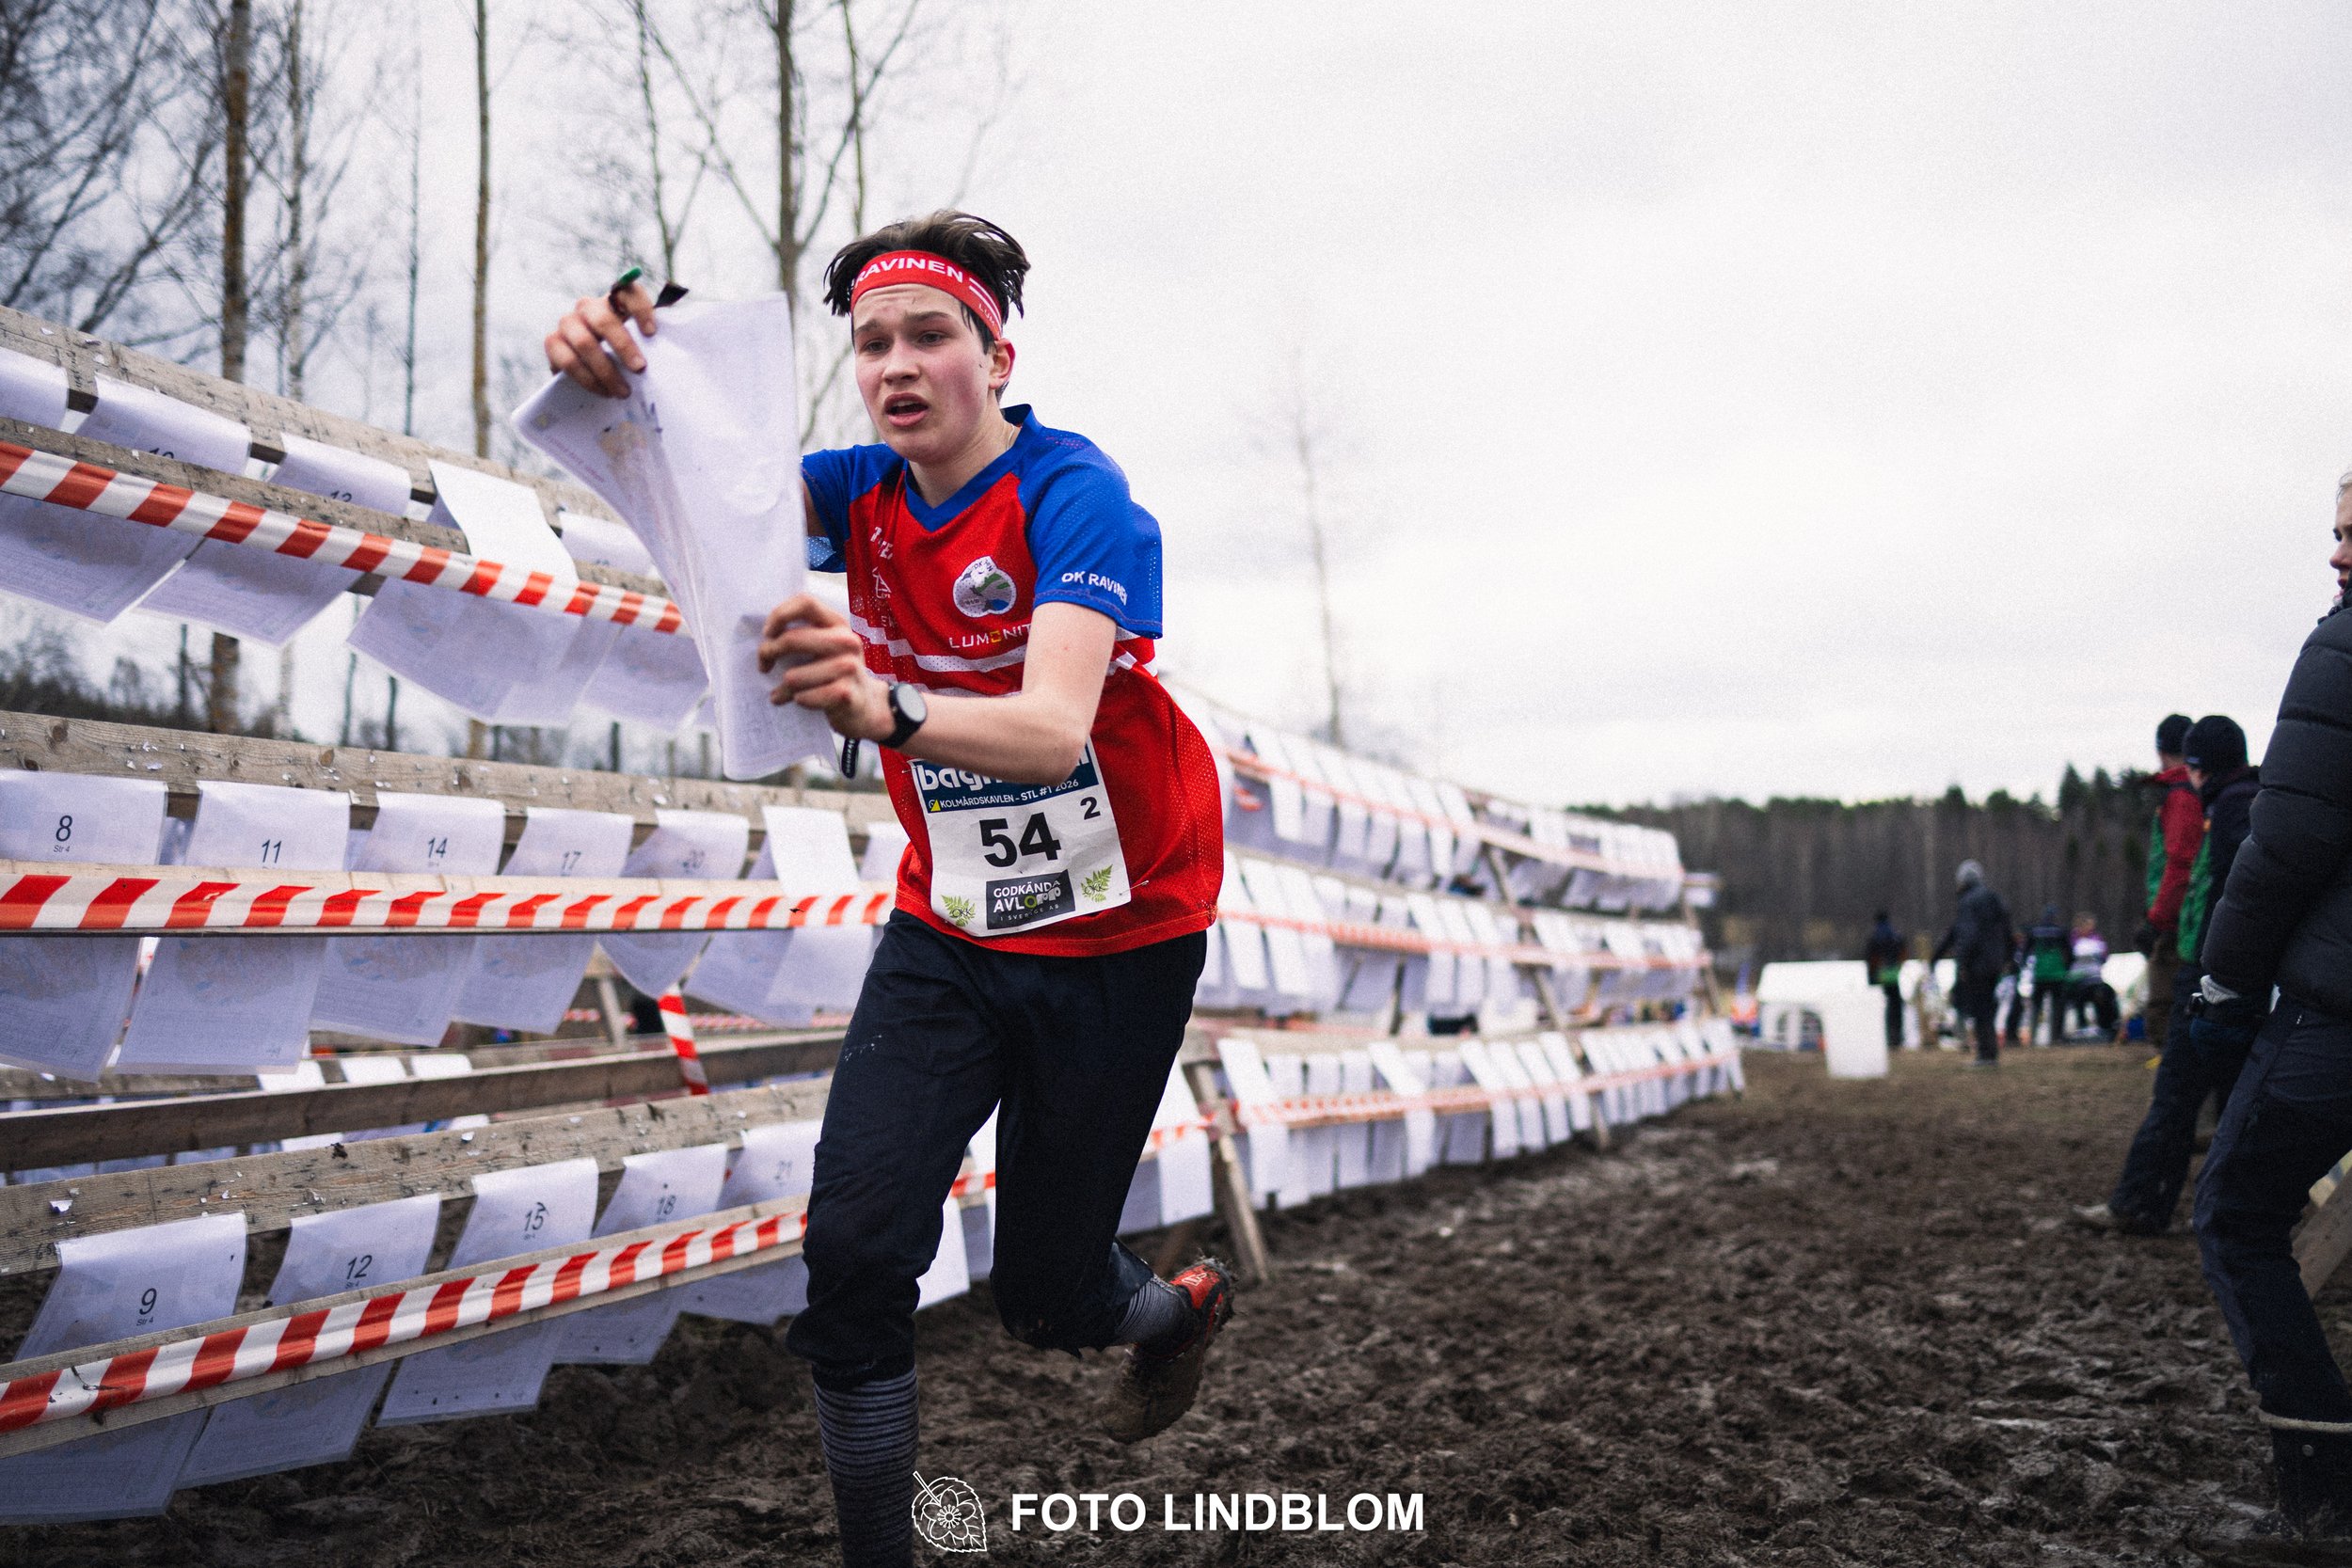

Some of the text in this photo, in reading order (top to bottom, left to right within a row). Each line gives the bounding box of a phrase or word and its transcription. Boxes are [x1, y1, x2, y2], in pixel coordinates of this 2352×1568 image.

[855, 257, 963, 289] RAVINEN
[1061, 570, 1086, 584] OK
[940, 795, 1015, 809] KOLMÅRDSKAVLEN
[1020, 788, 1039, 801] STL
[1039, 785, 1053, 797] #1
[1079, 796, 1102, 821] 2
[55, 815, 73, 843] 8
[978, 812, 1062, 868] 54
[261, 839, 282, 863] 11
[427, 837, 448, 859] 14
[993, 879, 1061, 898] GODKÄNDA
[346, 1255, 373, 1280] 12
[138, 1287, 158, 1316] 9
